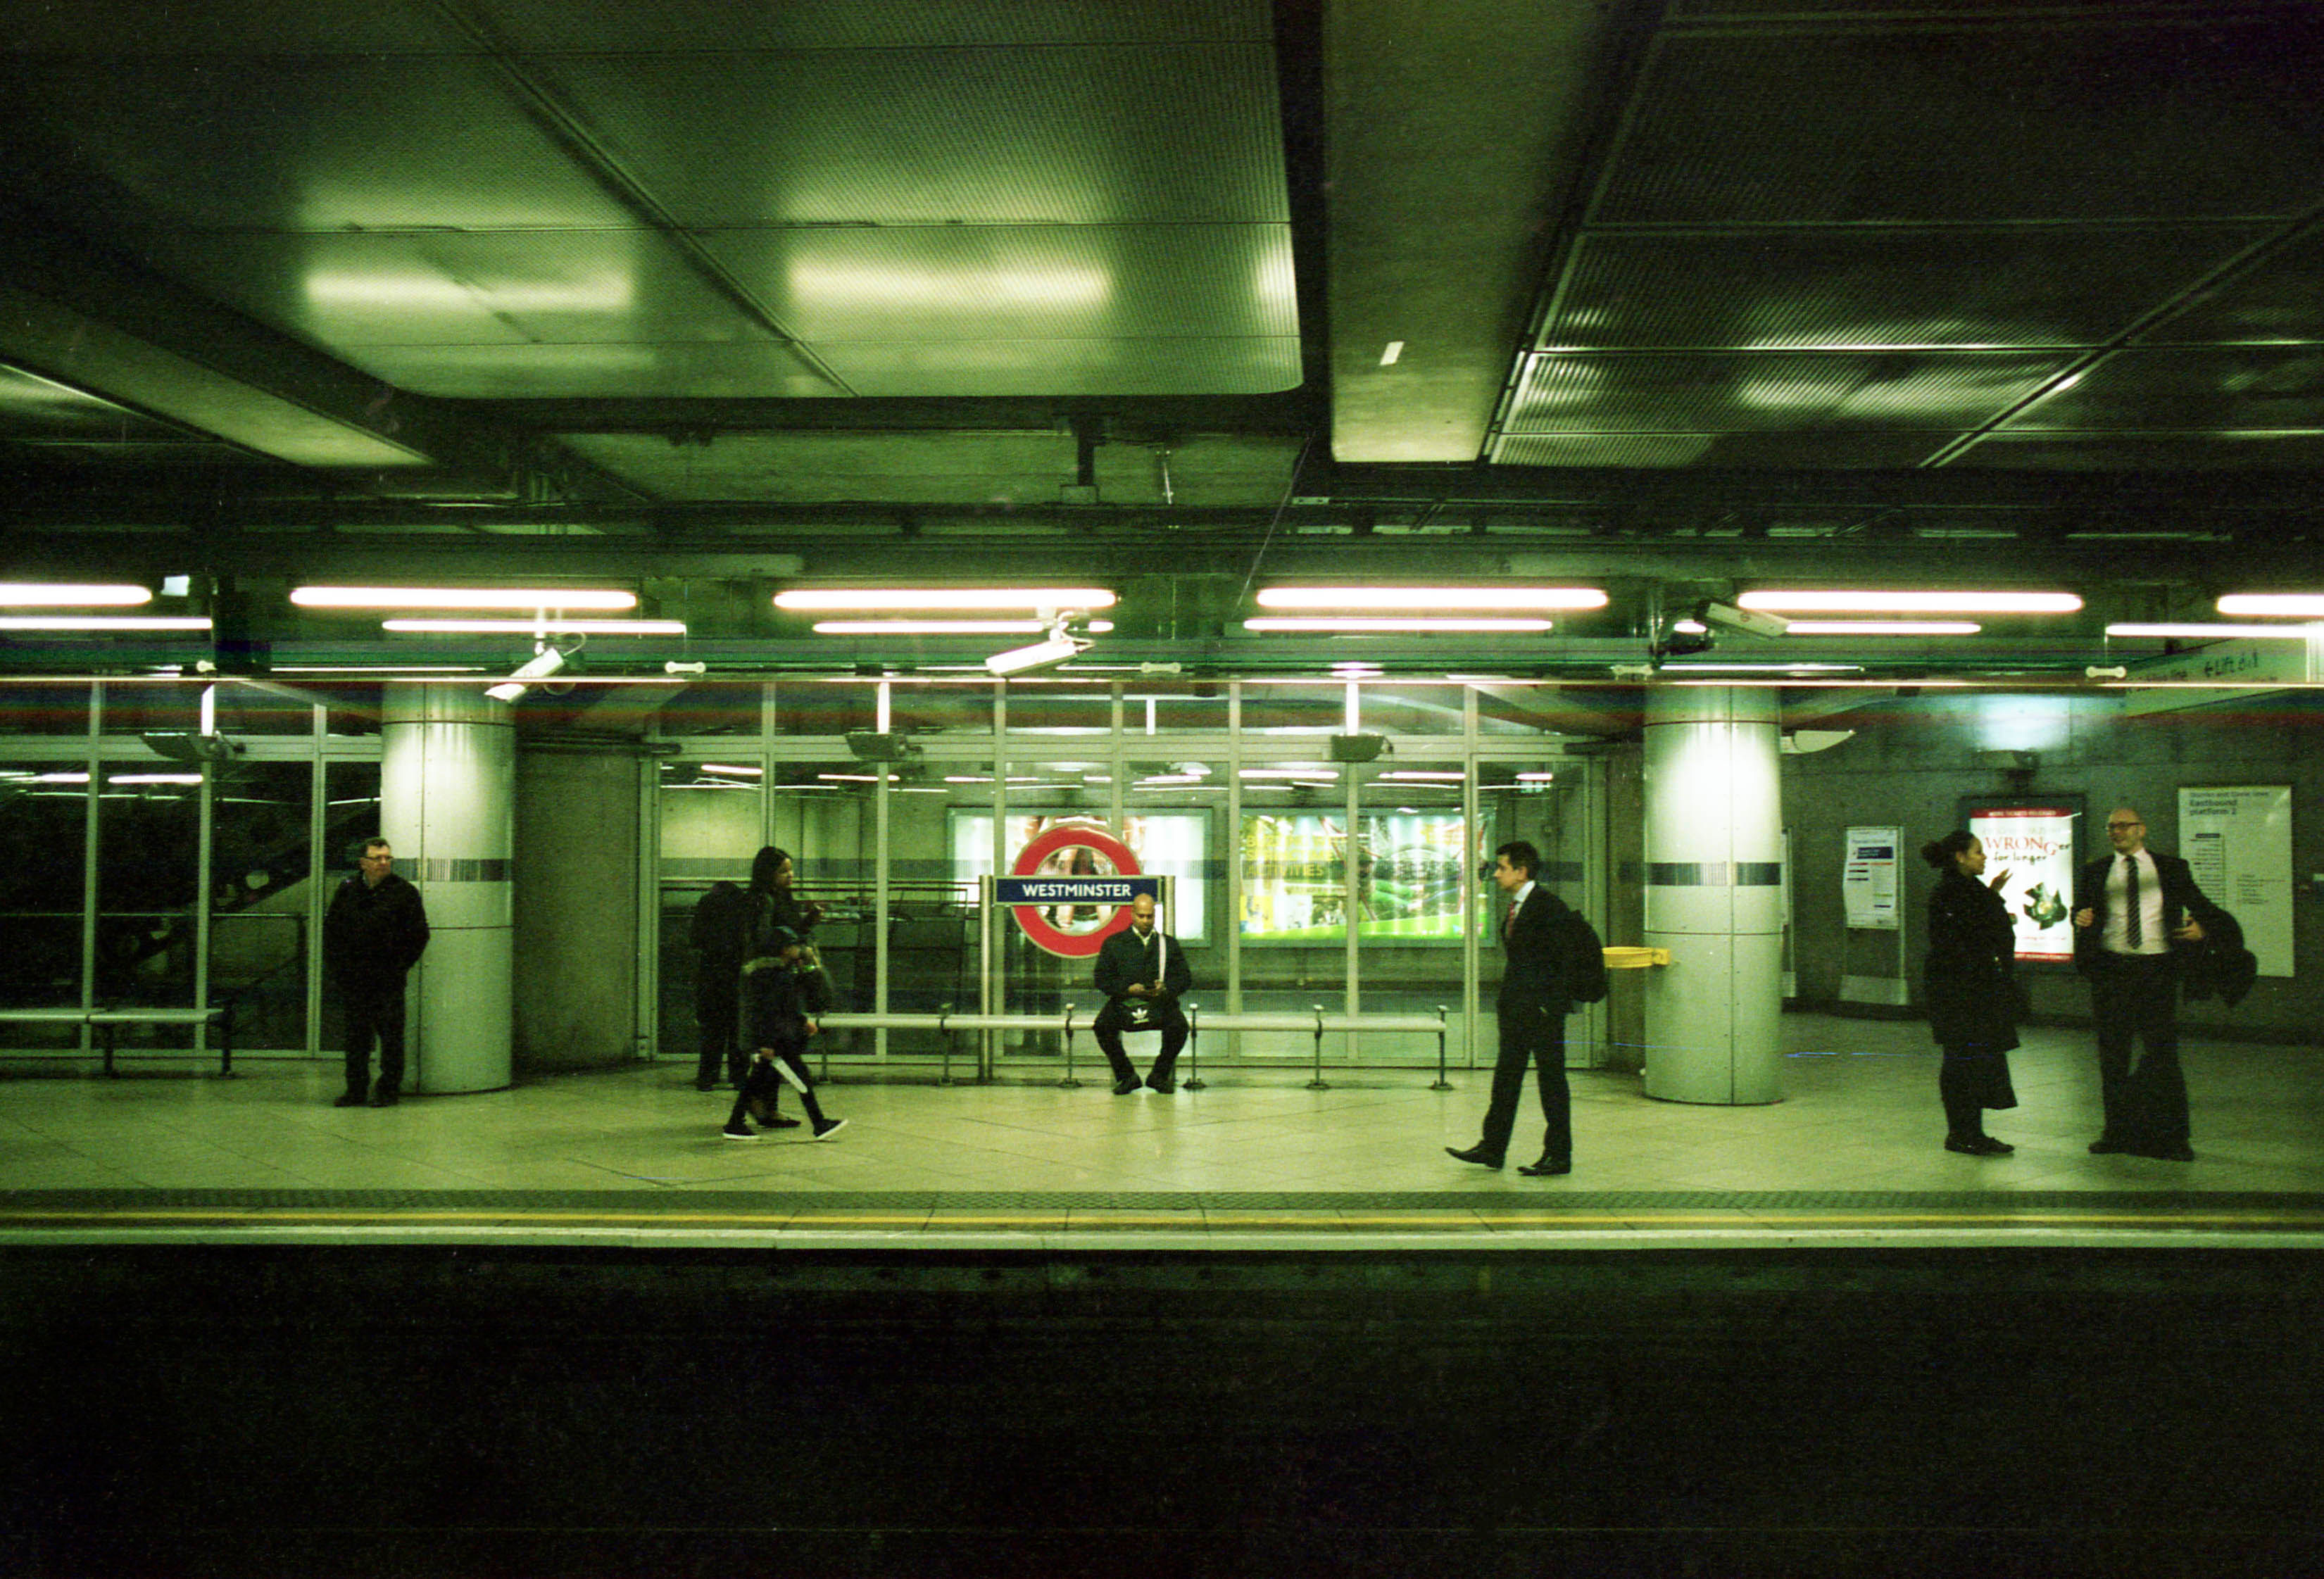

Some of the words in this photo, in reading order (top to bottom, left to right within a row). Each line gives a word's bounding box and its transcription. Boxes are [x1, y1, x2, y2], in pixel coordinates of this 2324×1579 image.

[1994, 851, 2009, 862] for
[2013, 851, 2047, 866] longer
[1022, 884, 1131, 897] WESTMINSTER
